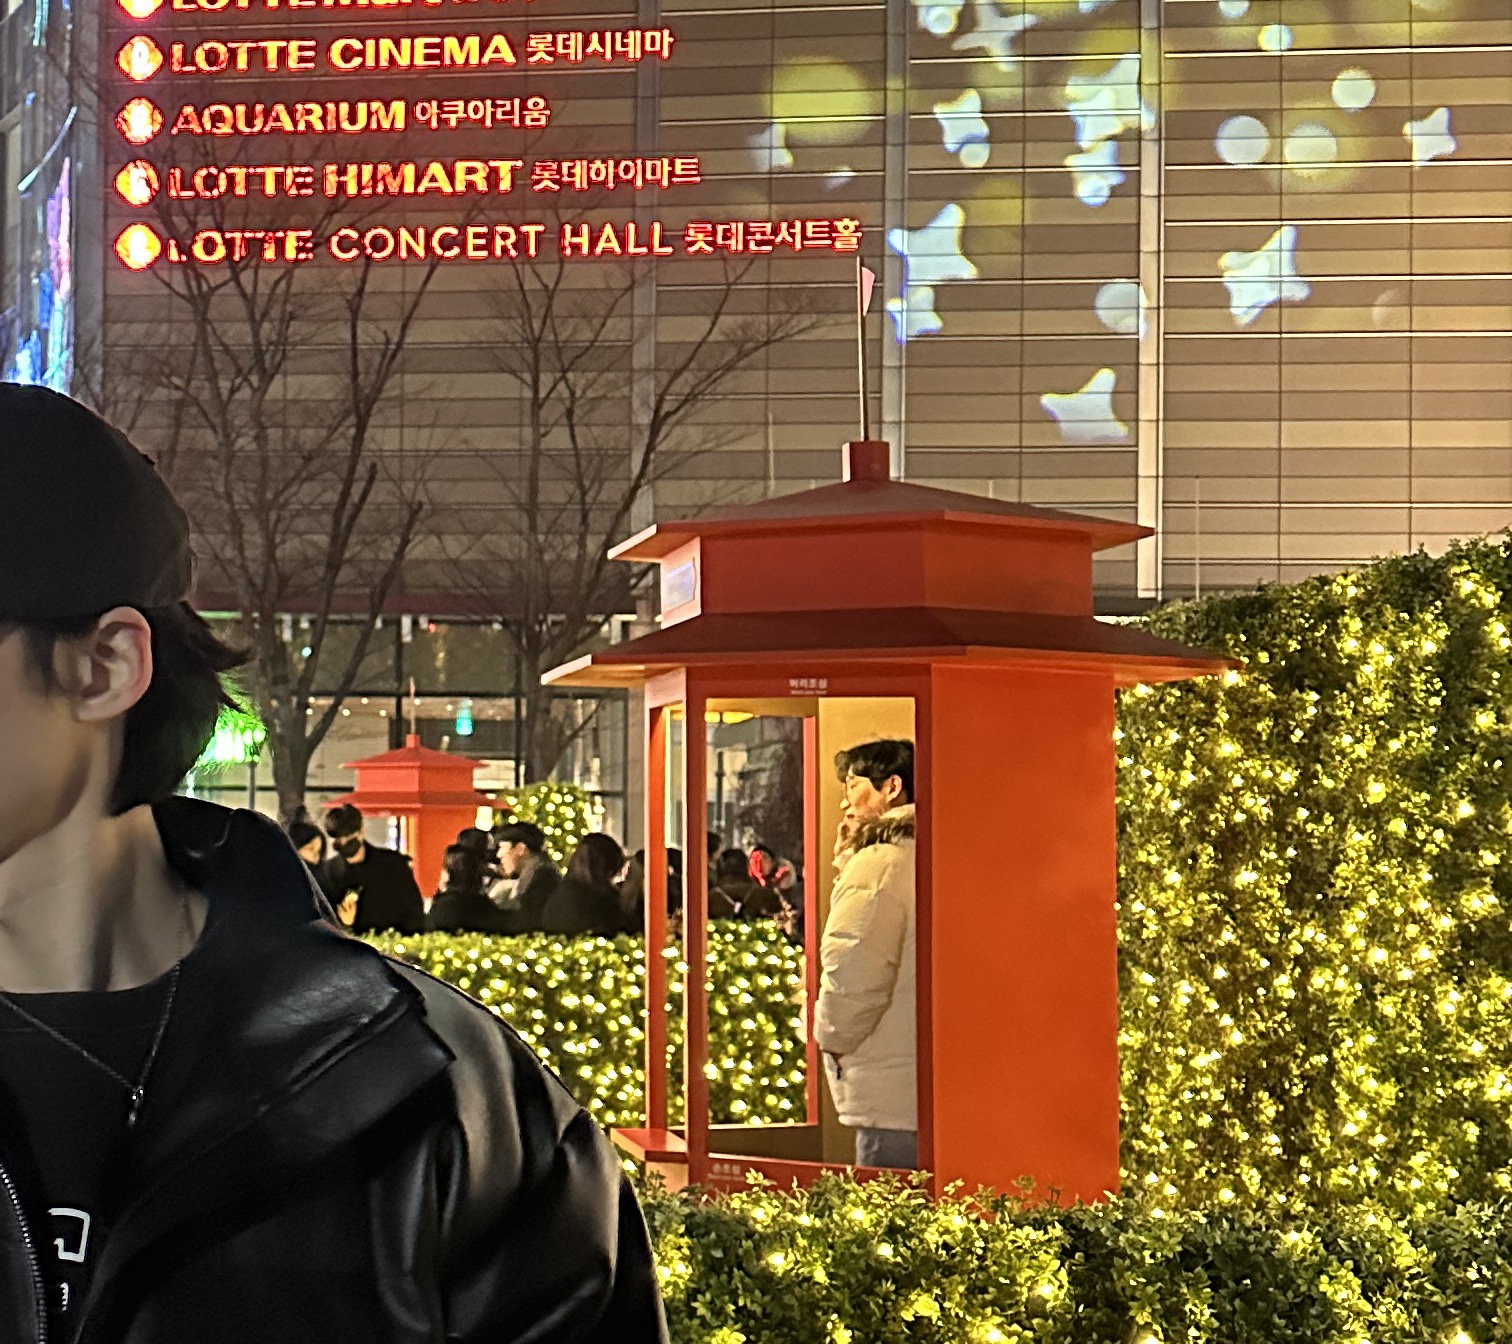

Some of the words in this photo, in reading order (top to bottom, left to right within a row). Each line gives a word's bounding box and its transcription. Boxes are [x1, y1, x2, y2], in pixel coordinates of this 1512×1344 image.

[170, 39, 318, 74] LOTTE
[328, 33, 518, 73] CINEMA
[525, 28, 676, 66] 롯데시네마
[169, 99, 407, 136] AQUARIUM
[414, 96, 552, 131] 아쿠아리움
[168, 165, 316, 199] LOTTE
[323, 159, 526, 199] HIMART
[529, 156, 702, 193] 롯데하이마트
[167, 228, 315, 264] LOTTE
[328, 224, 546, 262] CONCERT
[562, 220, 675, 258] HALL
[683, 216, 864, 255] 롯데콘서트홀
